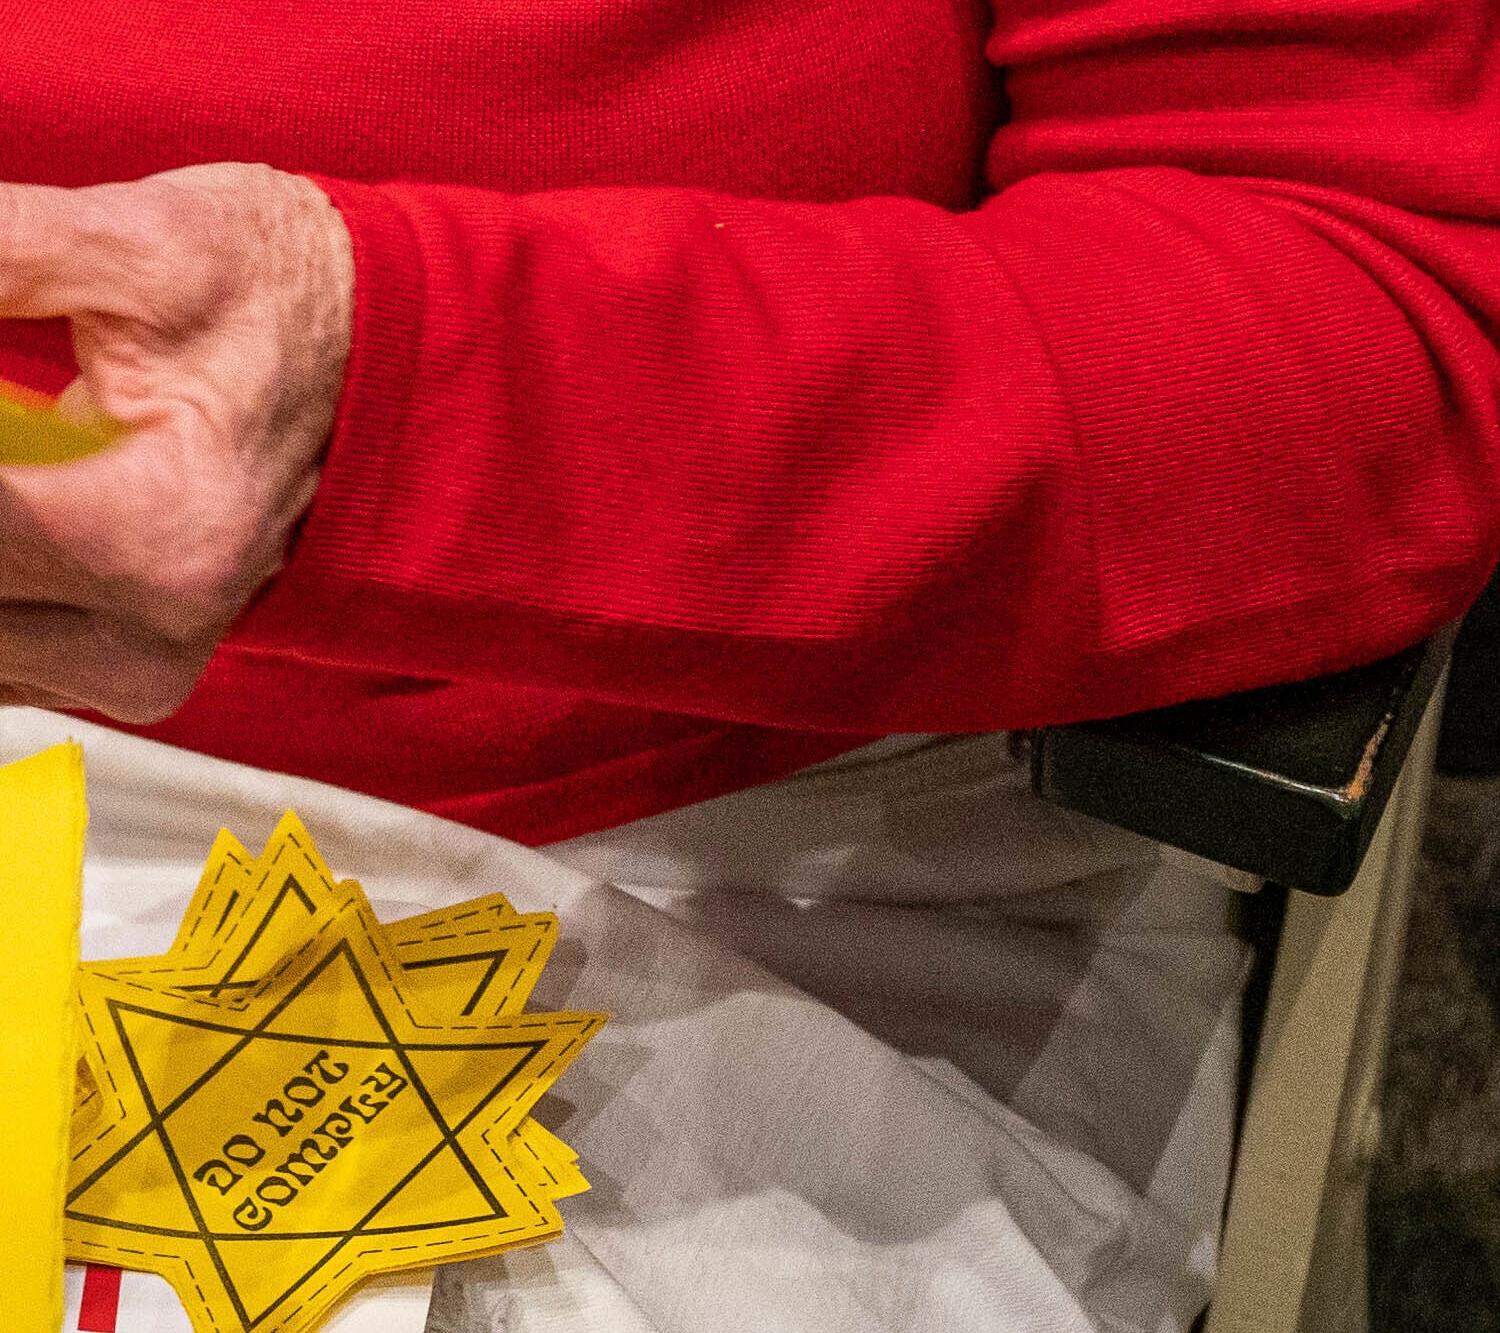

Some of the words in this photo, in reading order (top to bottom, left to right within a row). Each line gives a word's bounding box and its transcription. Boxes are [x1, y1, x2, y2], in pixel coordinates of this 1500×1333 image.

[193, 1134, 267, 1196] DO
[252, 1049, 349, 1138] NOT
[232, 1061, 409, 1231] COMPLY
